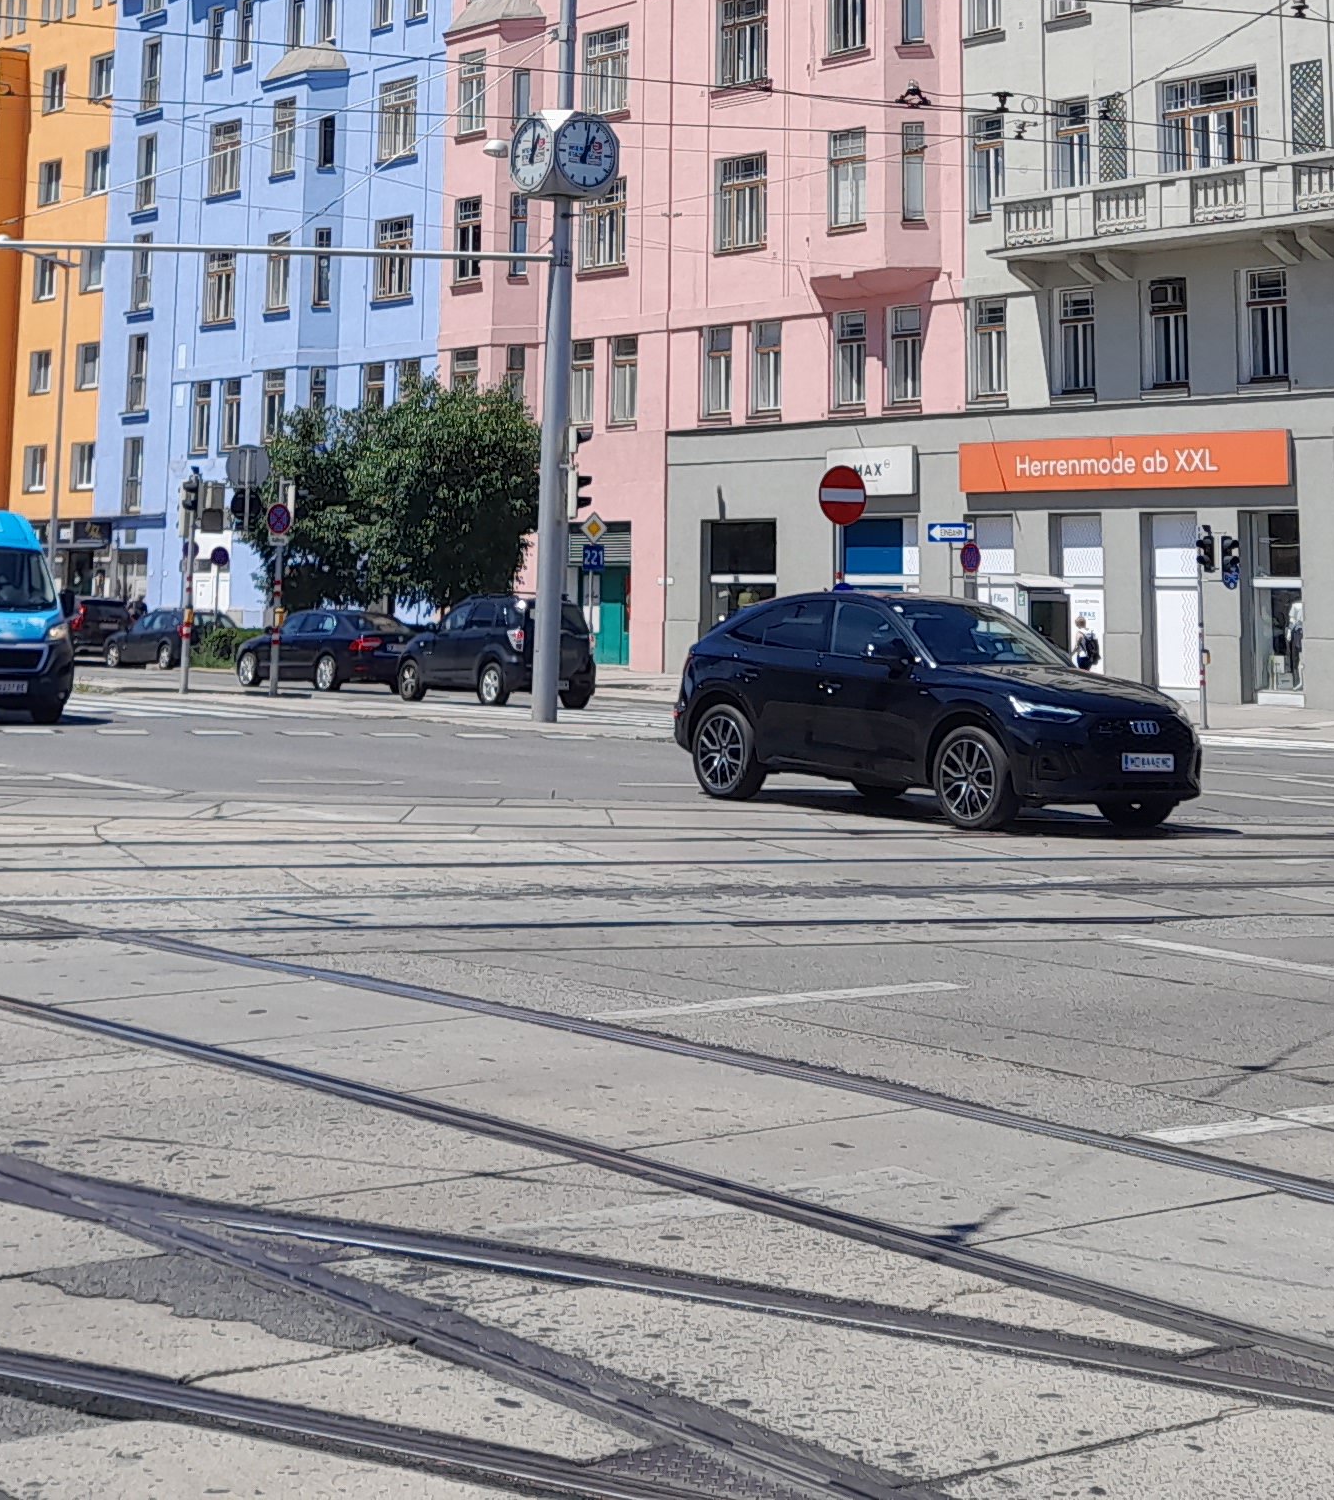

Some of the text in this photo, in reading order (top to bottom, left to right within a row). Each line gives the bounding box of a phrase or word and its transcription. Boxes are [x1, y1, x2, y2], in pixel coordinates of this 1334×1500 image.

[853, 463, 883, 477] MAX
[1015, 449, 1218, 477] Herrenmode ab XXL
[584, 549, 604, 565] 221
